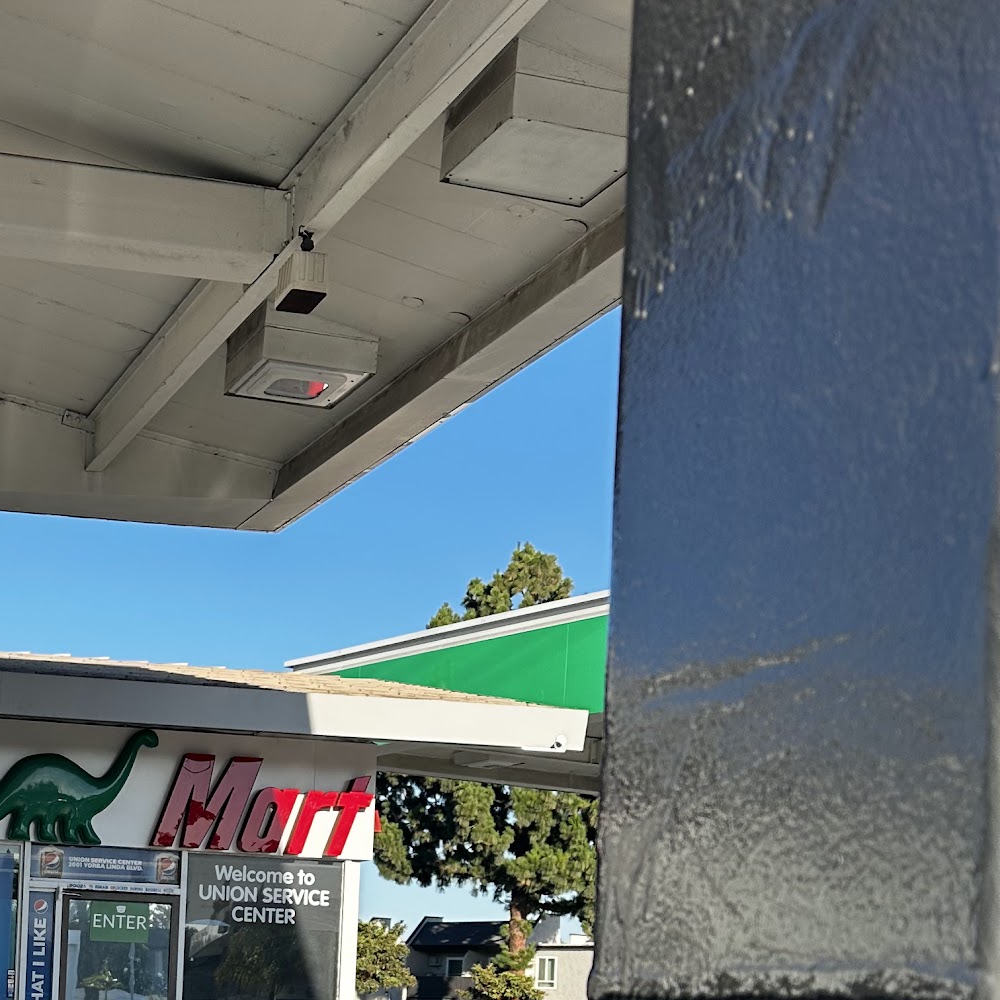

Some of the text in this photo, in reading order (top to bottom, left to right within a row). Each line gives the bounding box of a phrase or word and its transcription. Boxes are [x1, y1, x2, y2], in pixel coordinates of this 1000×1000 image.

[149, 752, 375, 858] Mart
[214, 865, 316, 886] Welcome to
[199, 884, 331, 907] UNION SERVICE
[93, 913, 147, 930] ENTER
[231, 906, 296, 925] CENTER
[33, 917, 47, 951] LIKE
